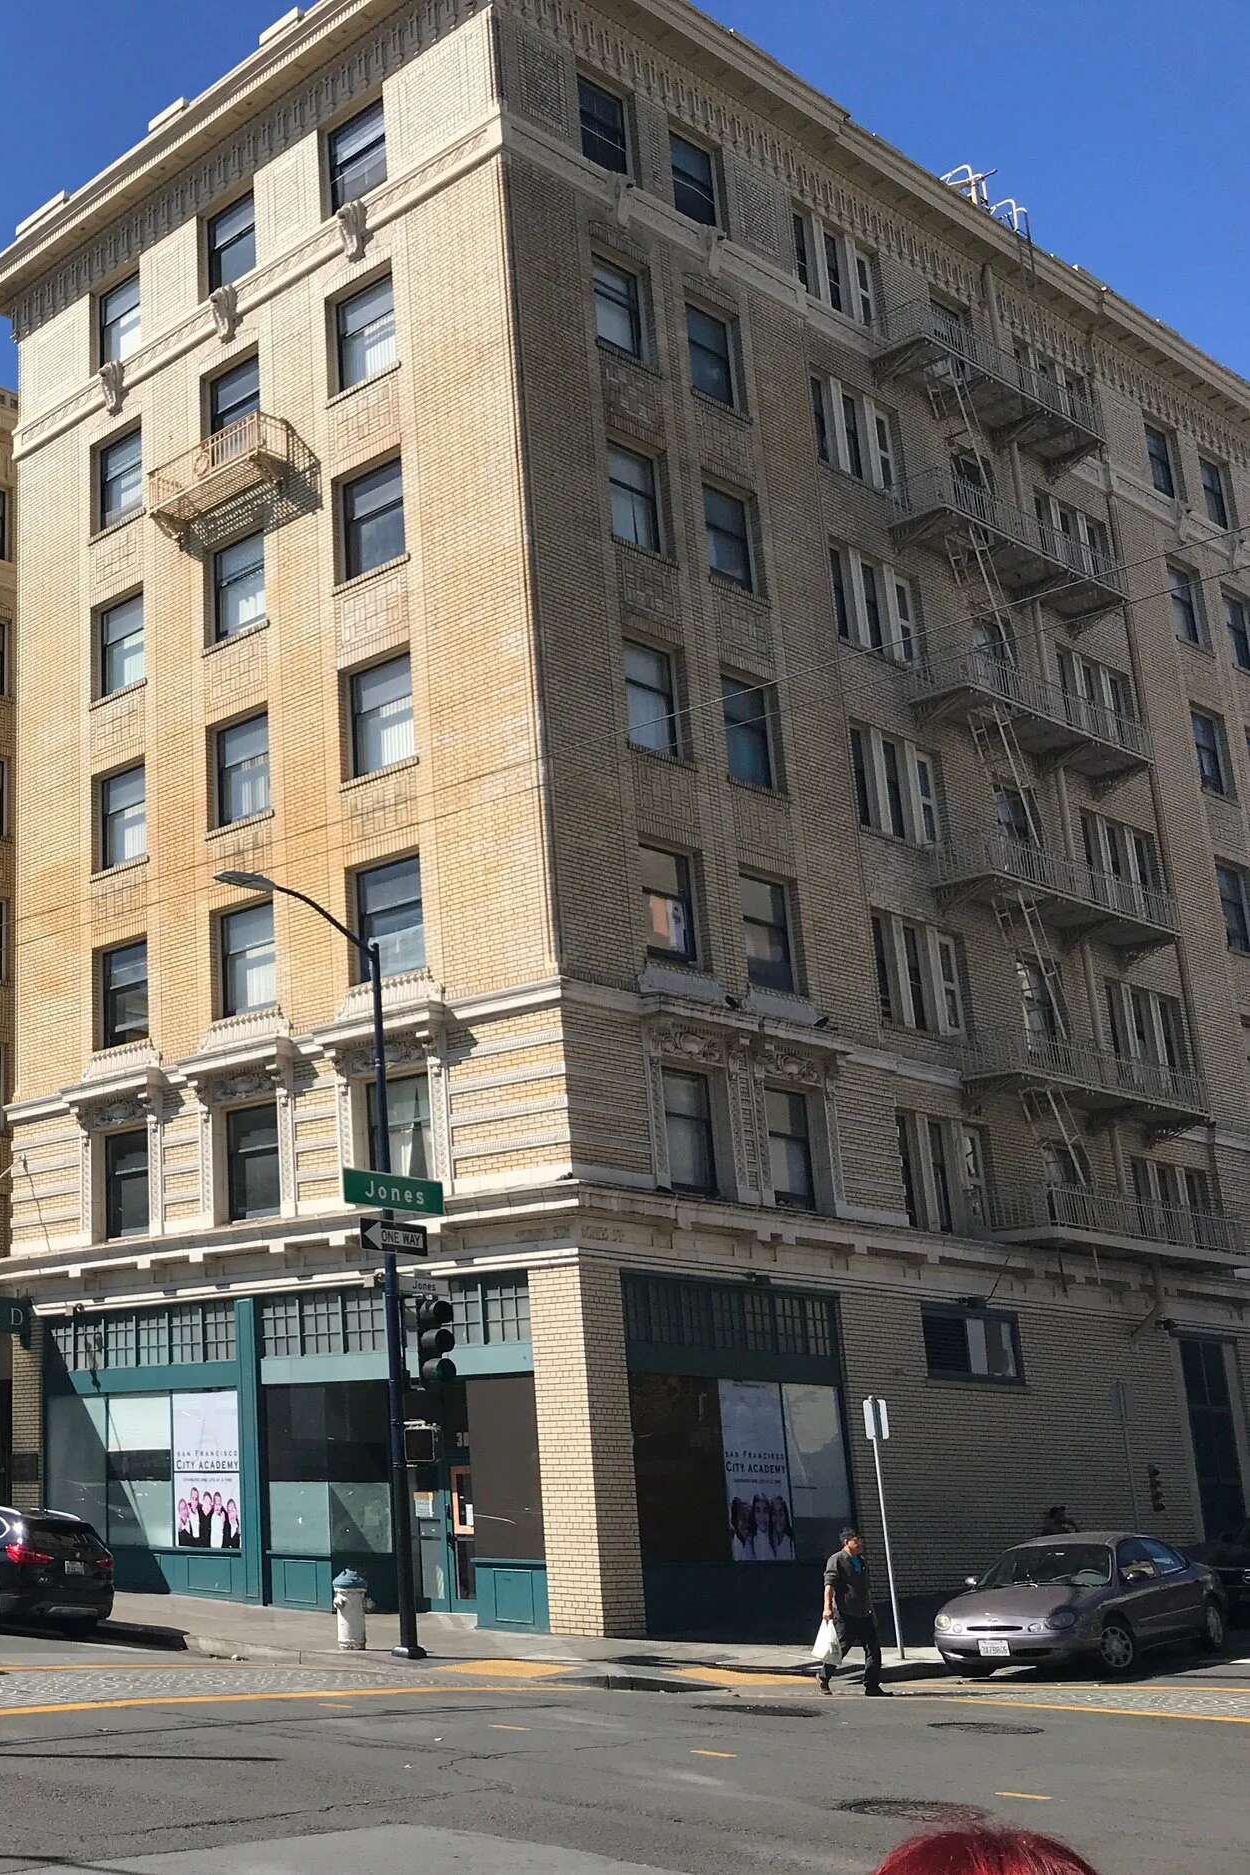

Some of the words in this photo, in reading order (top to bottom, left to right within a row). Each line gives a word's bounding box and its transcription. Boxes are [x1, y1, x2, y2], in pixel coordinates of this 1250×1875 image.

[365, 1181, 424, 1204] Jones
[381, 1230, 400, 1243] ONE
[402, 1232, 421, 1248] WAY
[412, 1280, 436, 1291] Jones
[743, 1450, 784, 1460] FRANCISCO
[176, 1459, 196, 1470] CITY
[199, 1460, 238, 1470] ACADEMY
[726, 1461, 745, 1472] CITY
[748, 1464, 785, 1474] ACADEMY
